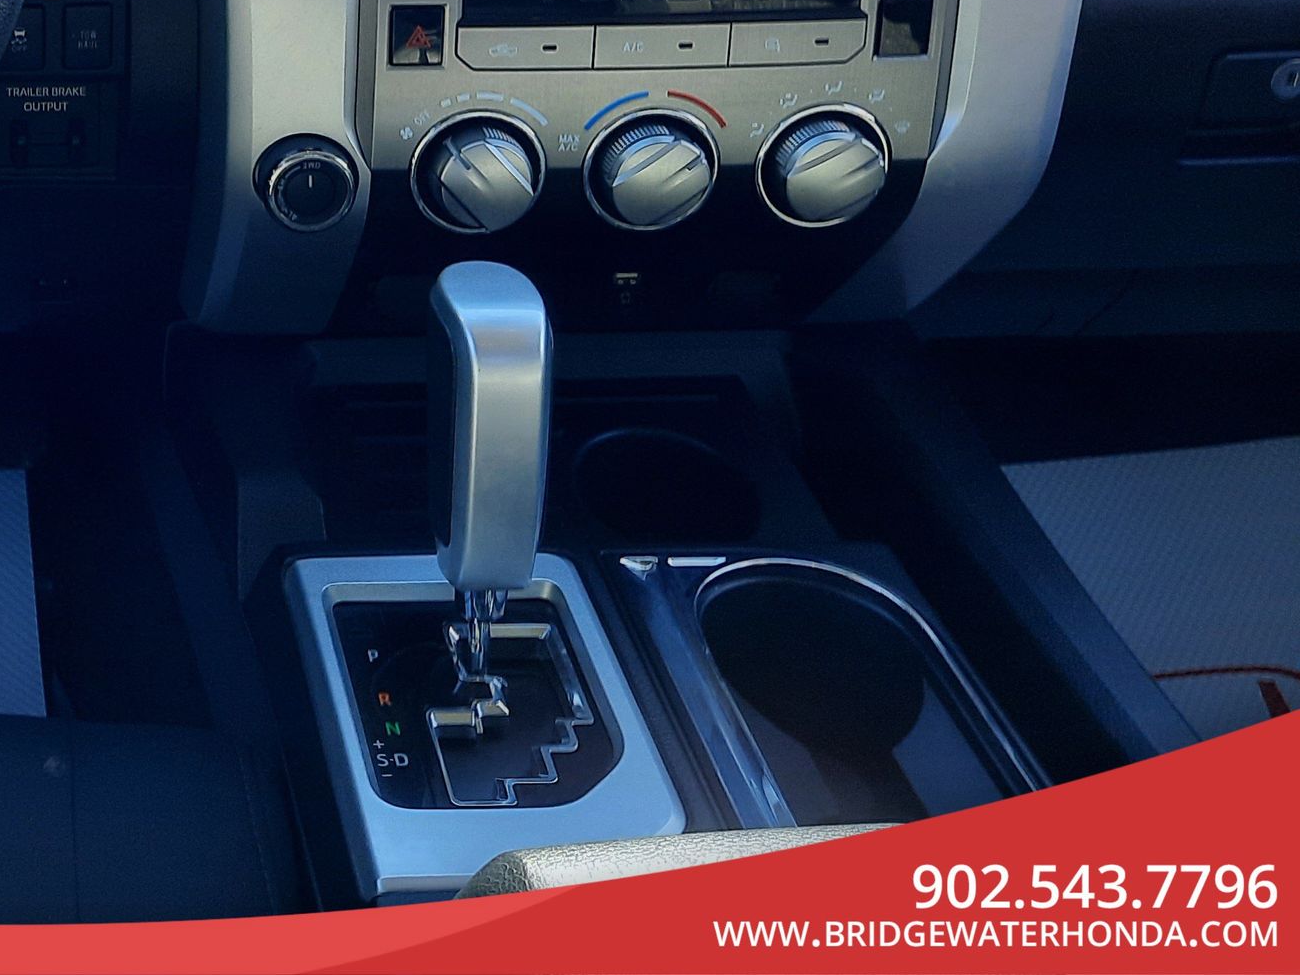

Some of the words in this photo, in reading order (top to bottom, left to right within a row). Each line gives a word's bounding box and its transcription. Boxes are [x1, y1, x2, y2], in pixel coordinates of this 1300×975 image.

[623, 41, 644, 53] A/C
[6, 87, 49, 97] TRAILER
[52, 86, 87, 97] BRAKE
[23, 101, 68, 112] OUTPUT
[367, 649, 379, 663] P
[378, 692, 392, 706] R
[385, 722, 401, 735] N
